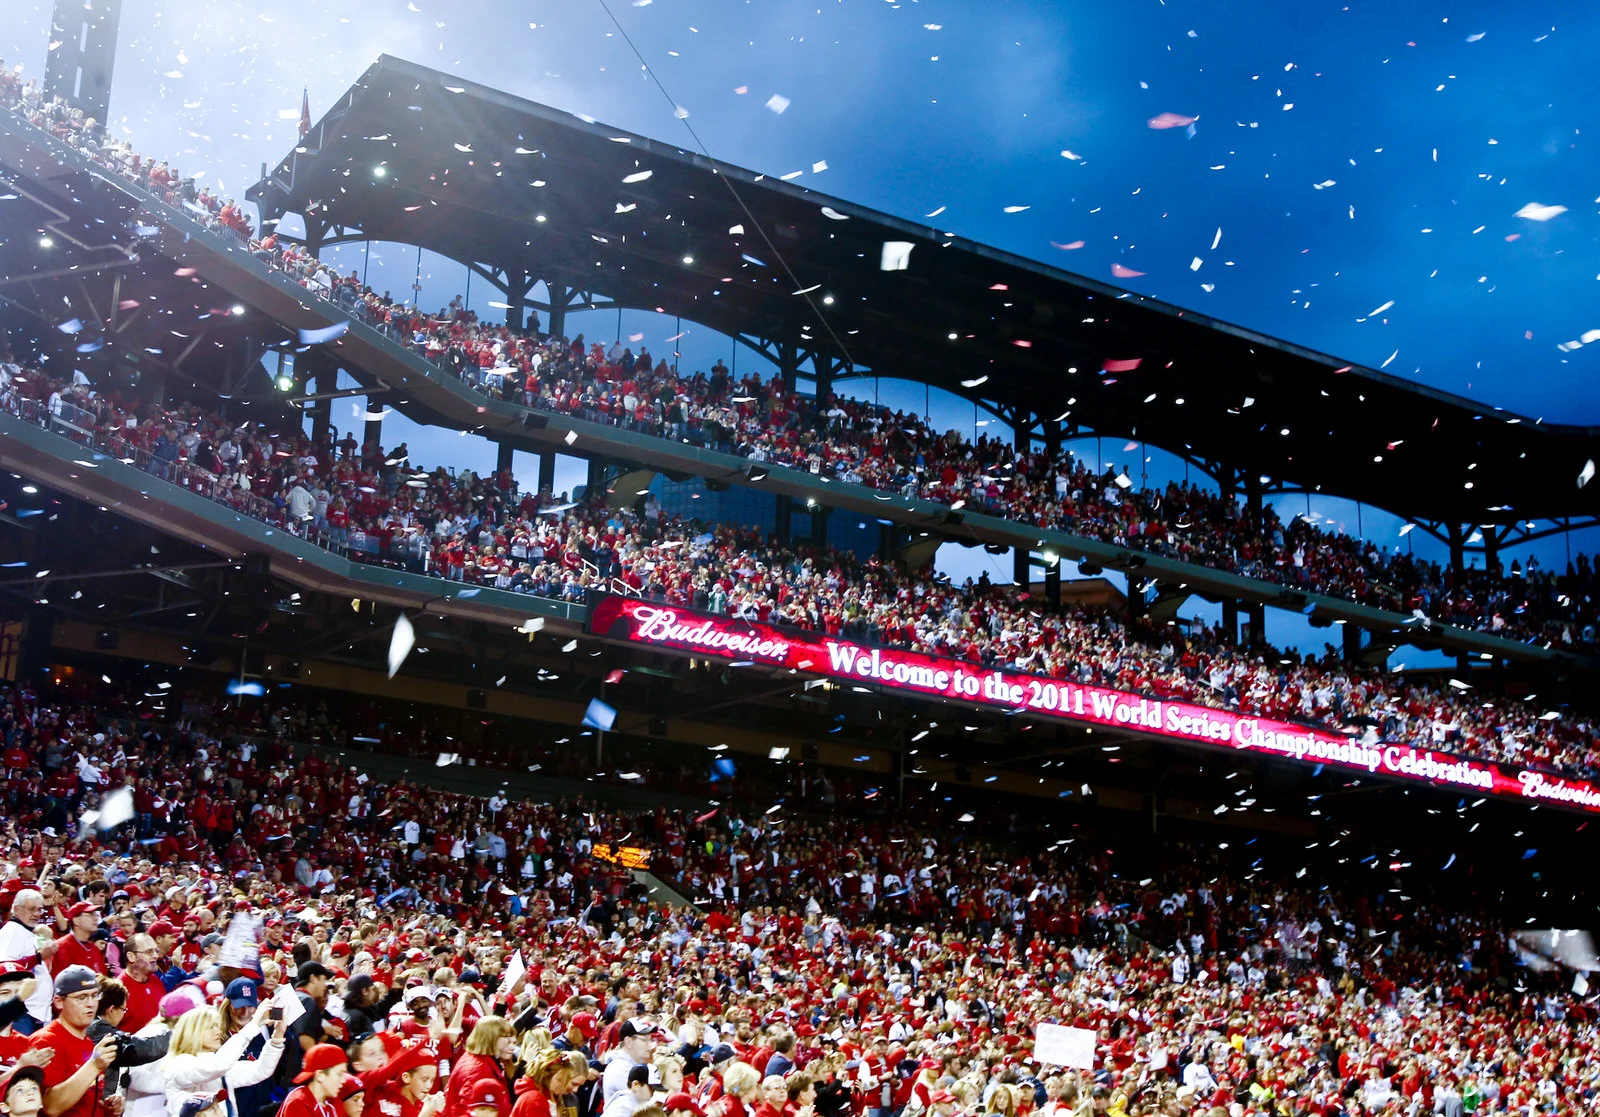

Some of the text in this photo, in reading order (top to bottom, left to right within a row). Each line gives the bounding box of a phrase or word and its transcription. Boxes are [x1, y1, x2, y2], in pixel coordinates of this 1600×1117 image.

[826, 642, 1493, 789] Welcome to the 2011 World Series Championship Celebration
